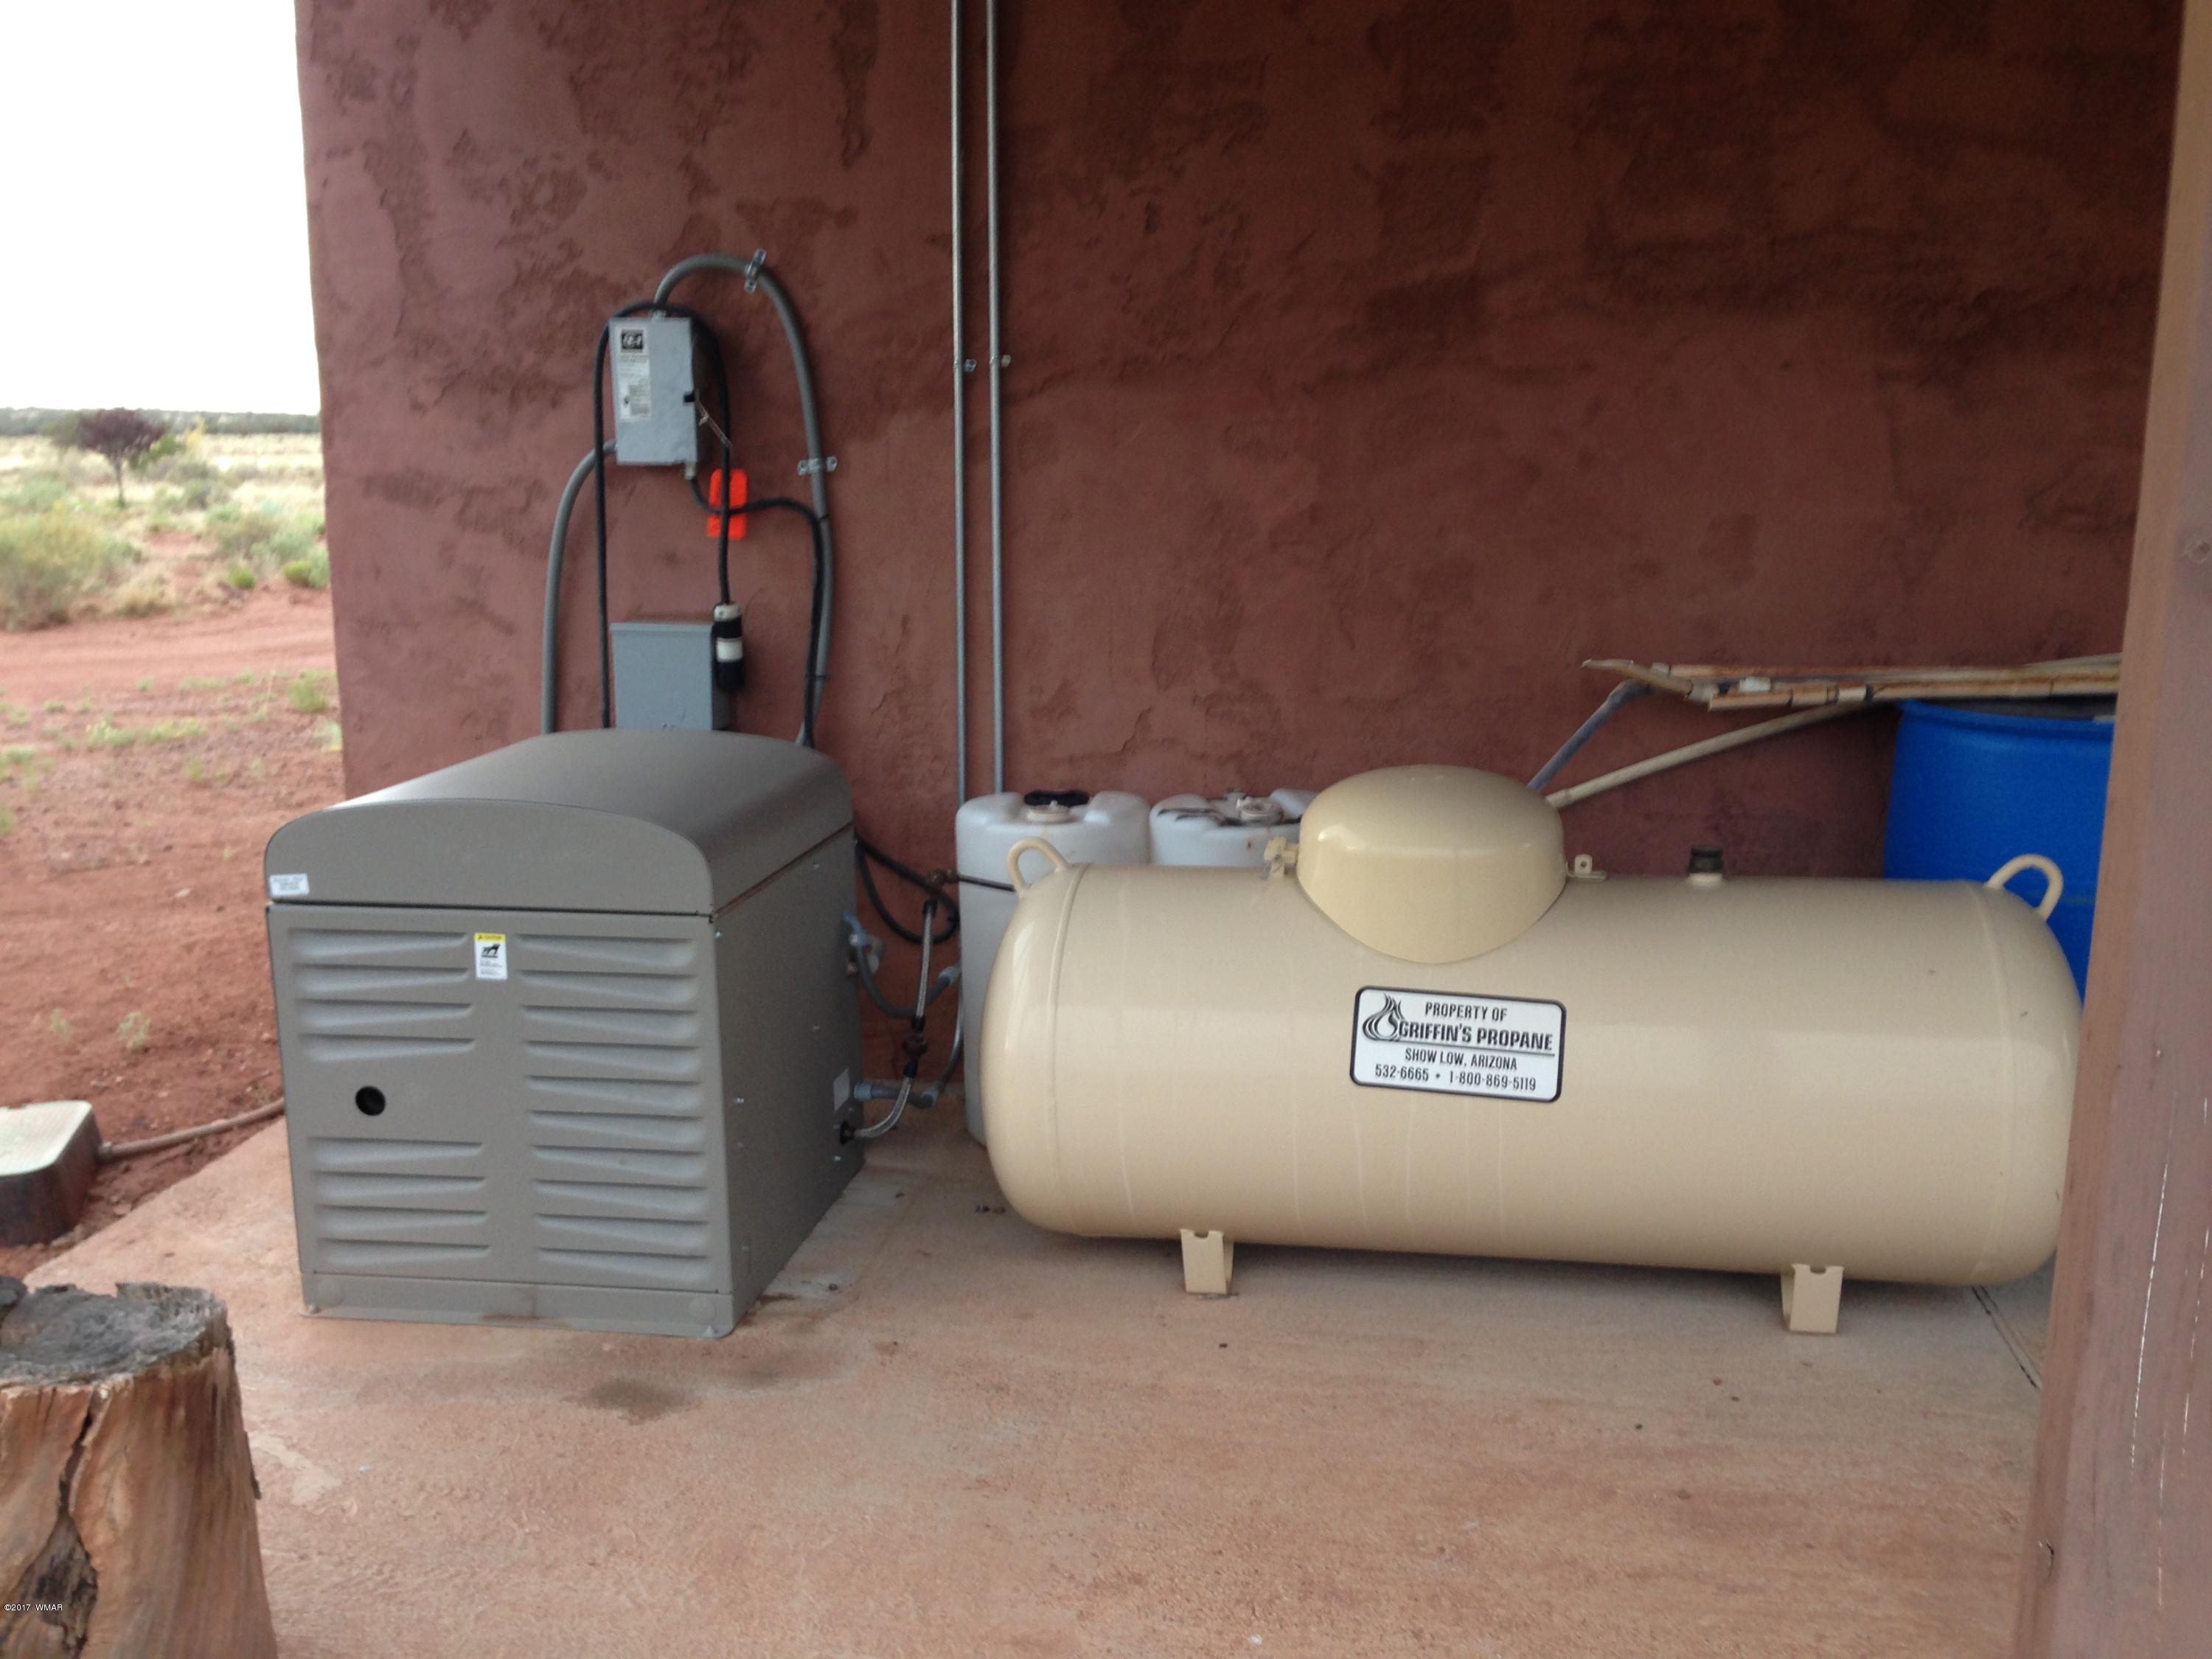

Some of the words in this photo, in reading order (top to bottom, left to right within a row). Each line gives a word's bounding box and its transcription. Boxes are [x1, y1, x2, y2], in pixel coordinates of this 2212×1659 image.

[1425, 1001, 1489, 1021] PROPERTY
[1492, 1006, 1508, 1022] OF
[1398, 1020, 1472, 1044] GRIFFIN'S
[1477, 1028, 1553, 1051] PROPANE
[1405, 1047, 1437, 1063] SHOW
[1440, 1051, 1467, 1067] LOW,
[1471, 1054, 1517, 1070] ARIZONA
[1375, 1063, 1429, 1082] 532-6665
[1450, 1071, 1537, 1091] 1-800-869-5119
